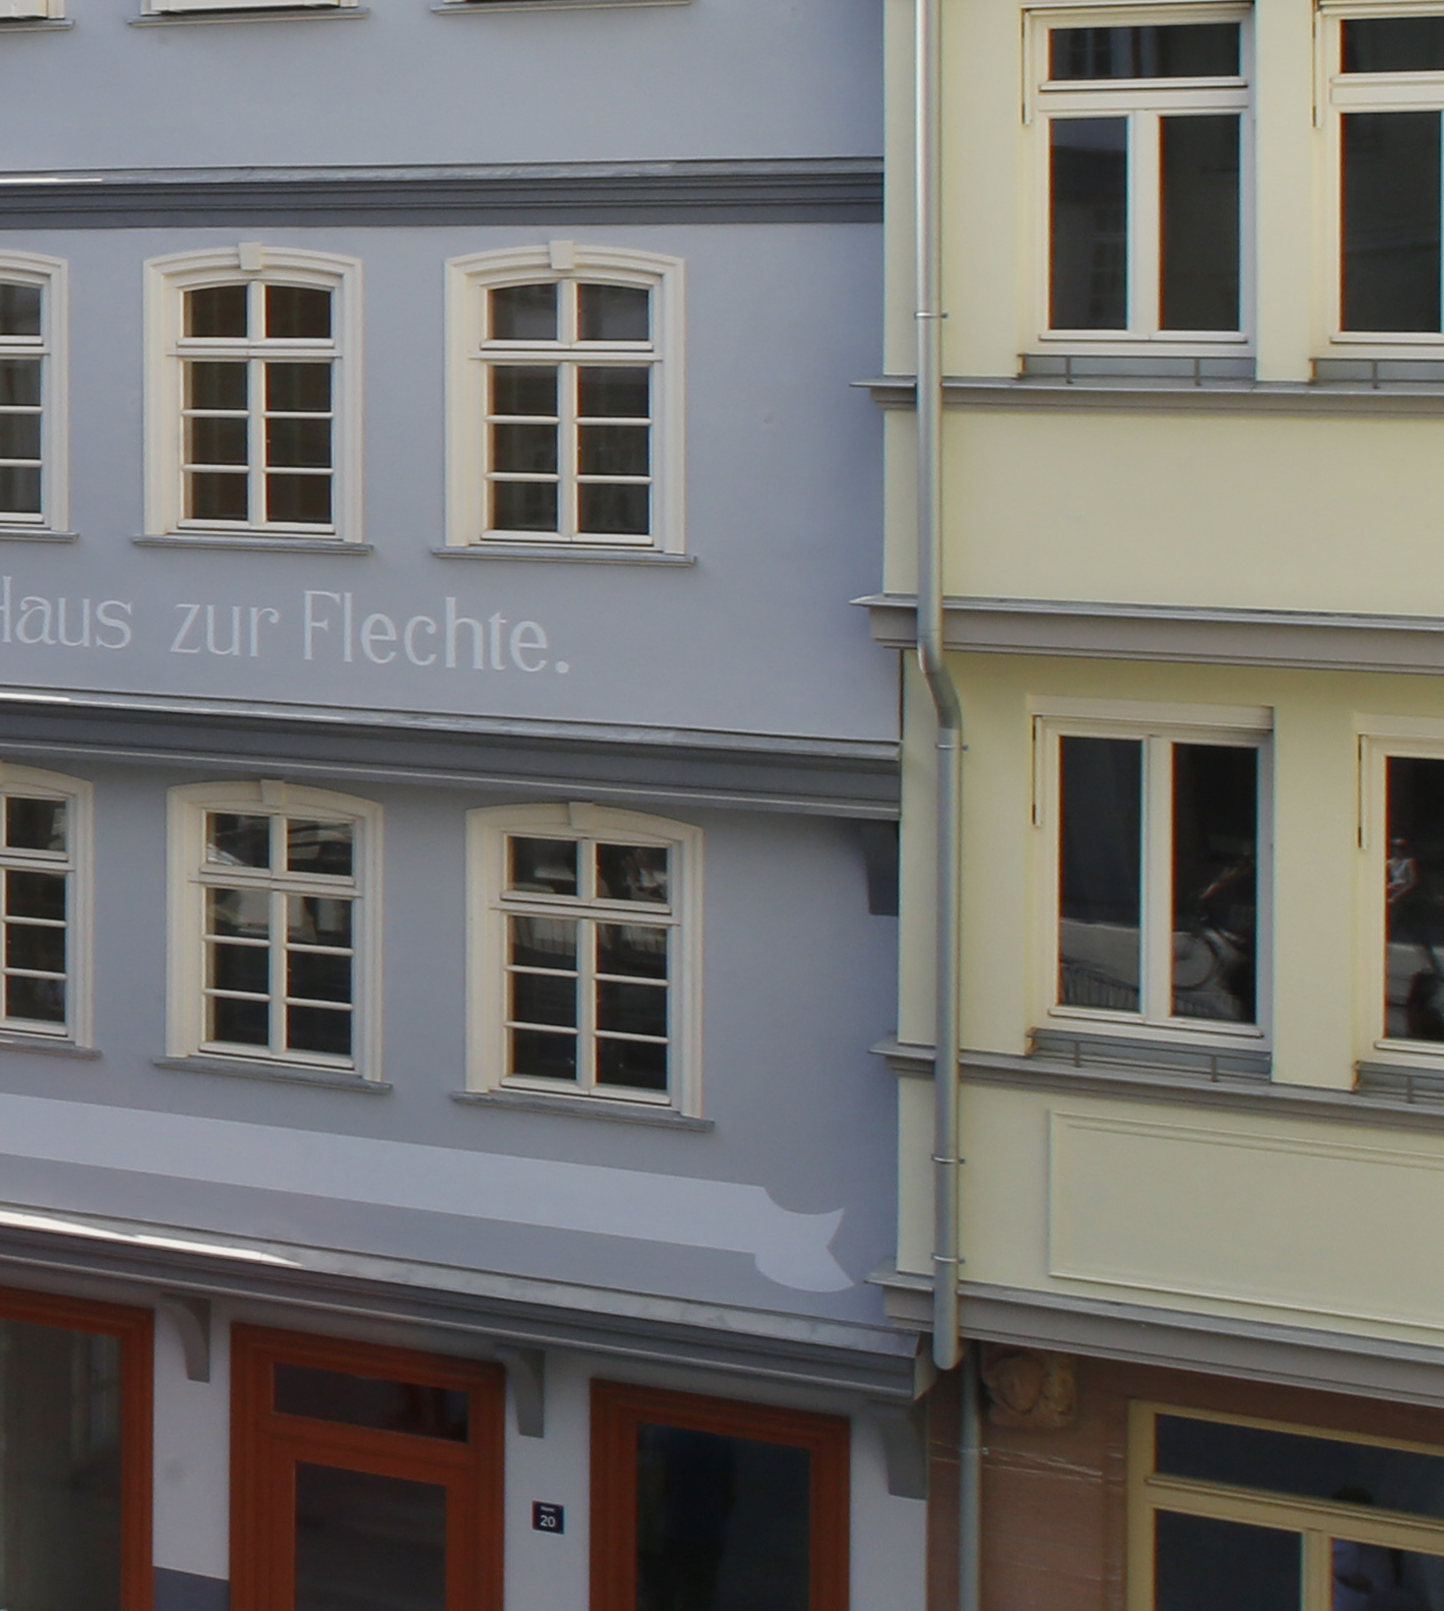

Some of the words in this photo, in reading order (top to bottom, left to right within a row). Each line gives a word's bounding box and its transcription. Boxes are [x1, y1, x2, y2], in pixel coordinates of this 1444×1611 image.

[170, 602, 279, 658] zur
[302, 590, 569, 674] Flechte.
[540, 1515, 556, 1527] 20
